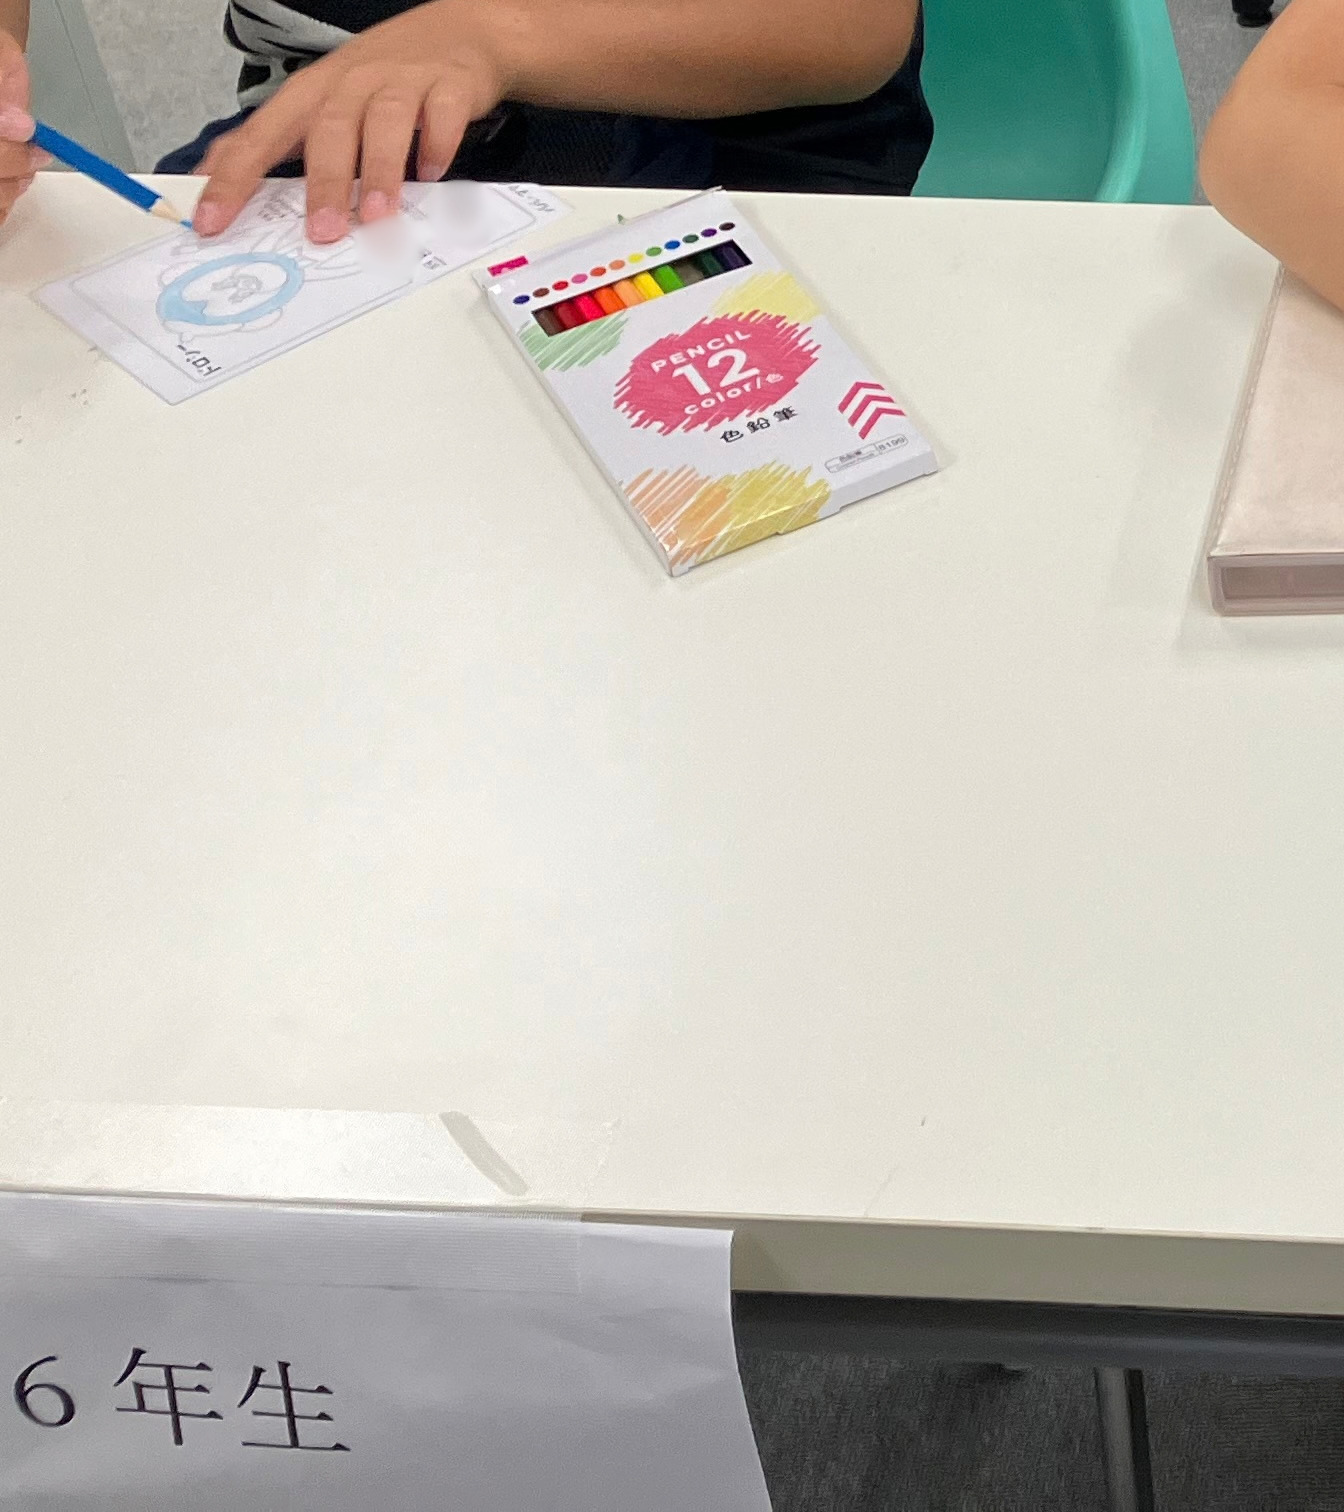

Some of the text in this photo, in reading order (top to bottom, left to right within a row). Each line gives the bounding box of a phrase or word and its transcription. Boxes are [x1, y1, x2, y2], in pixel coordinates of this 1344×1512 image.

[651, 331, 752, 373] PENCIL
[672, 348, 761, 396] 12
[720, 405, 798, 443] 色鉛筆
[13, 1347, 352, 1452] 6年生
